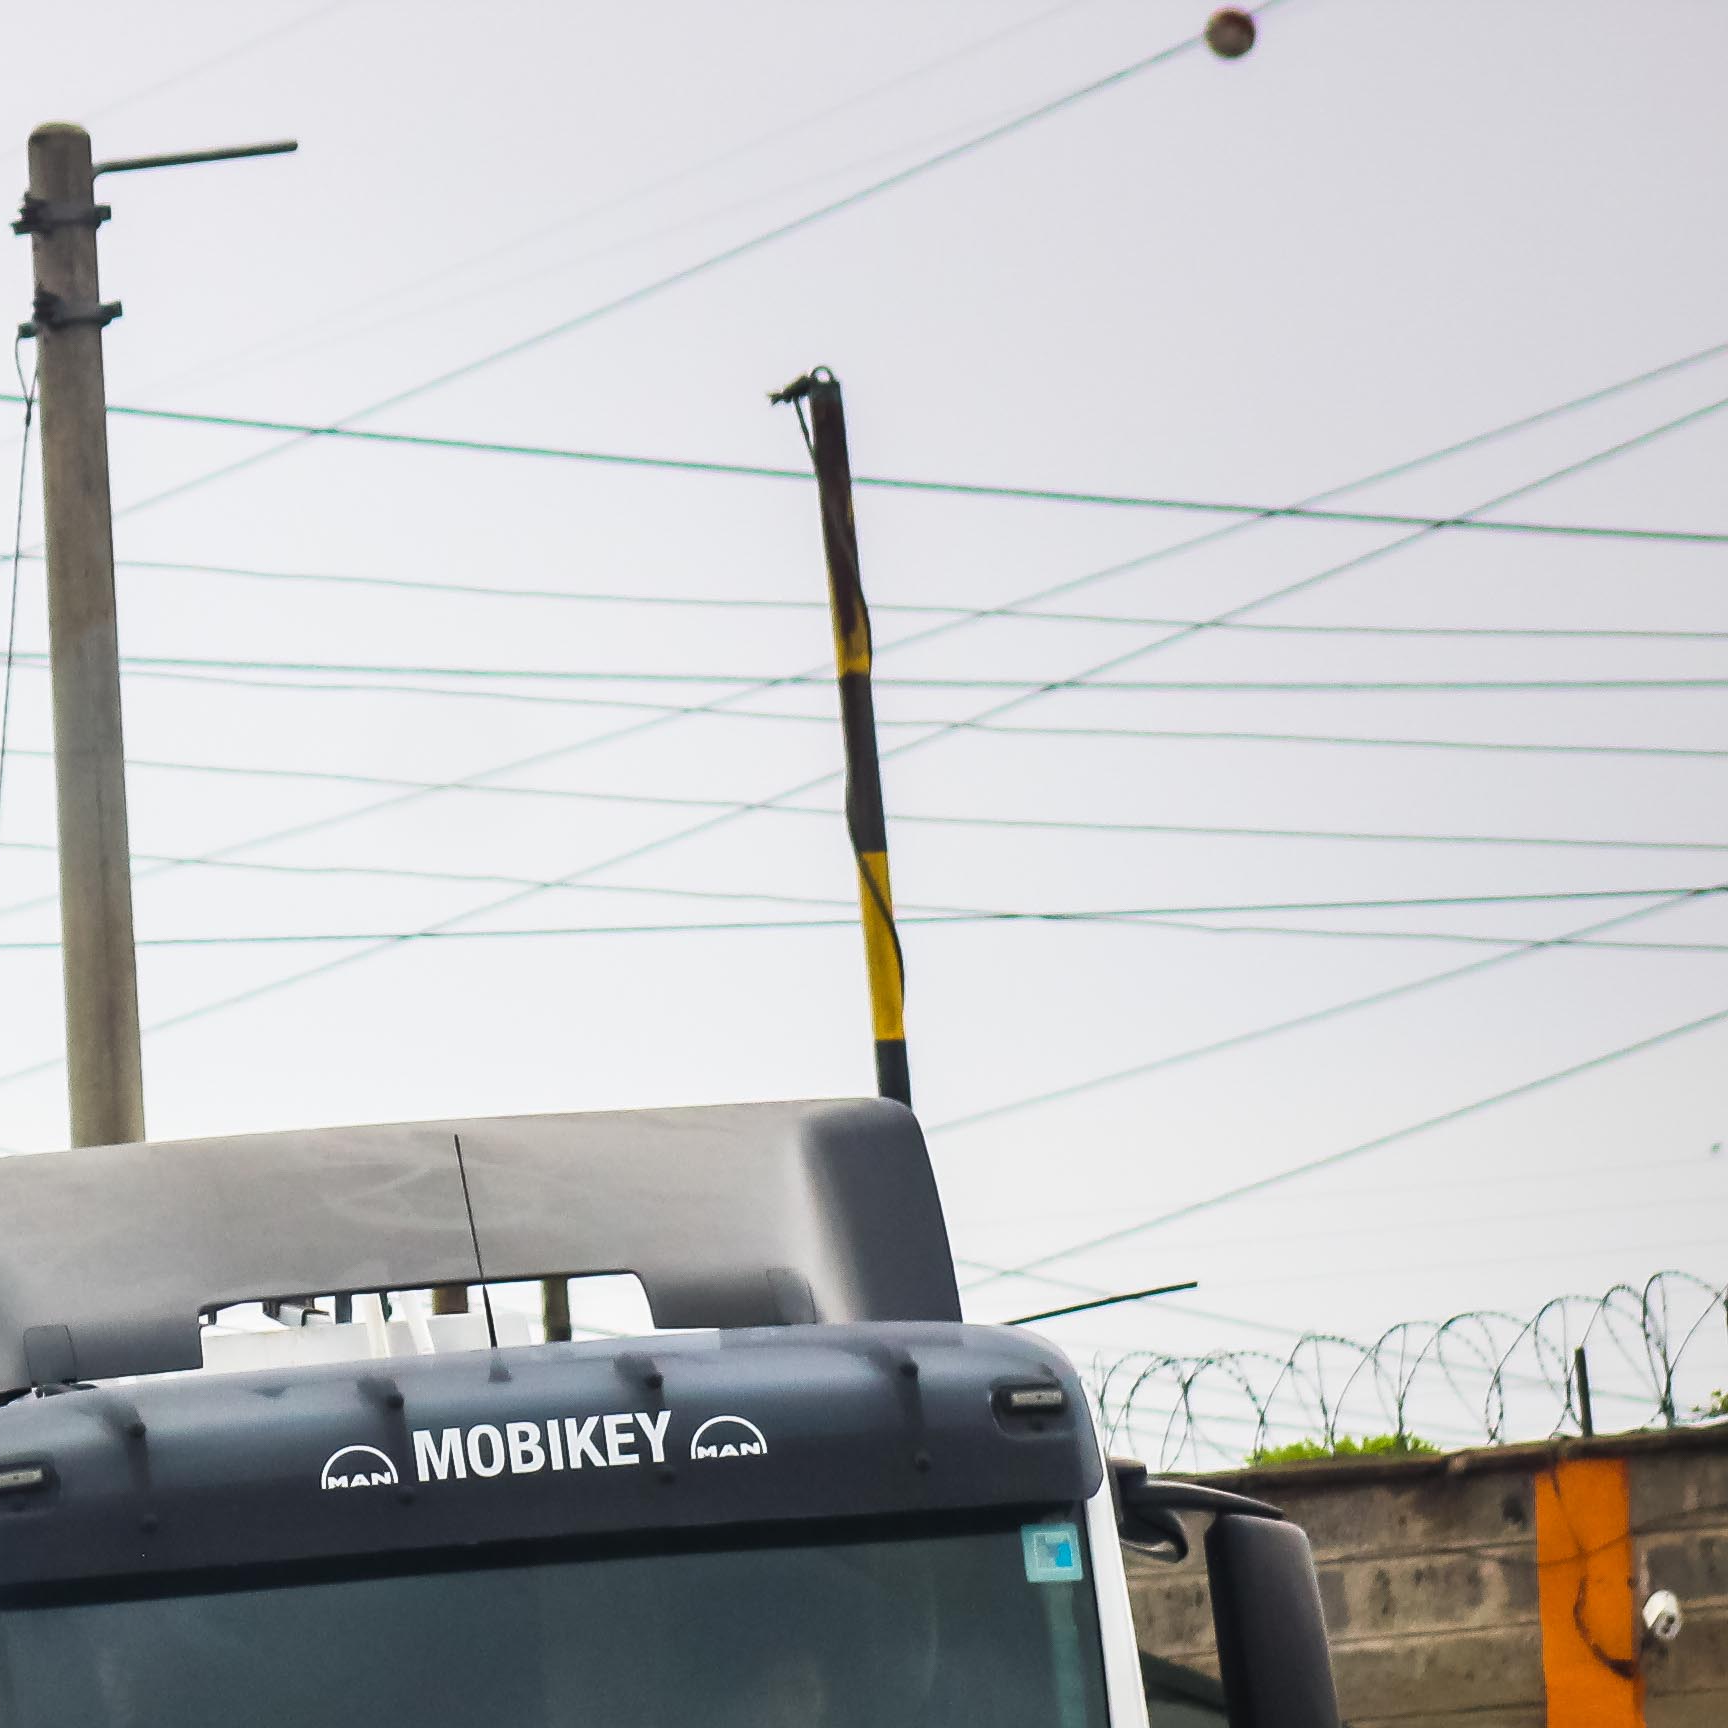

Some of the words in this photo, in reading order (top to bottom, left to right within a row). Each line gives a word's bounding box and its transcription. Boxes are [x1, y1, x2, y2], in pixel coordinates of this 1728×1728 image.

[327, 1471, 392, 1489] MAN
[412, 1410, 672, 1483] MOBIKEY
[695, 1441, 762, 1459] MAN
